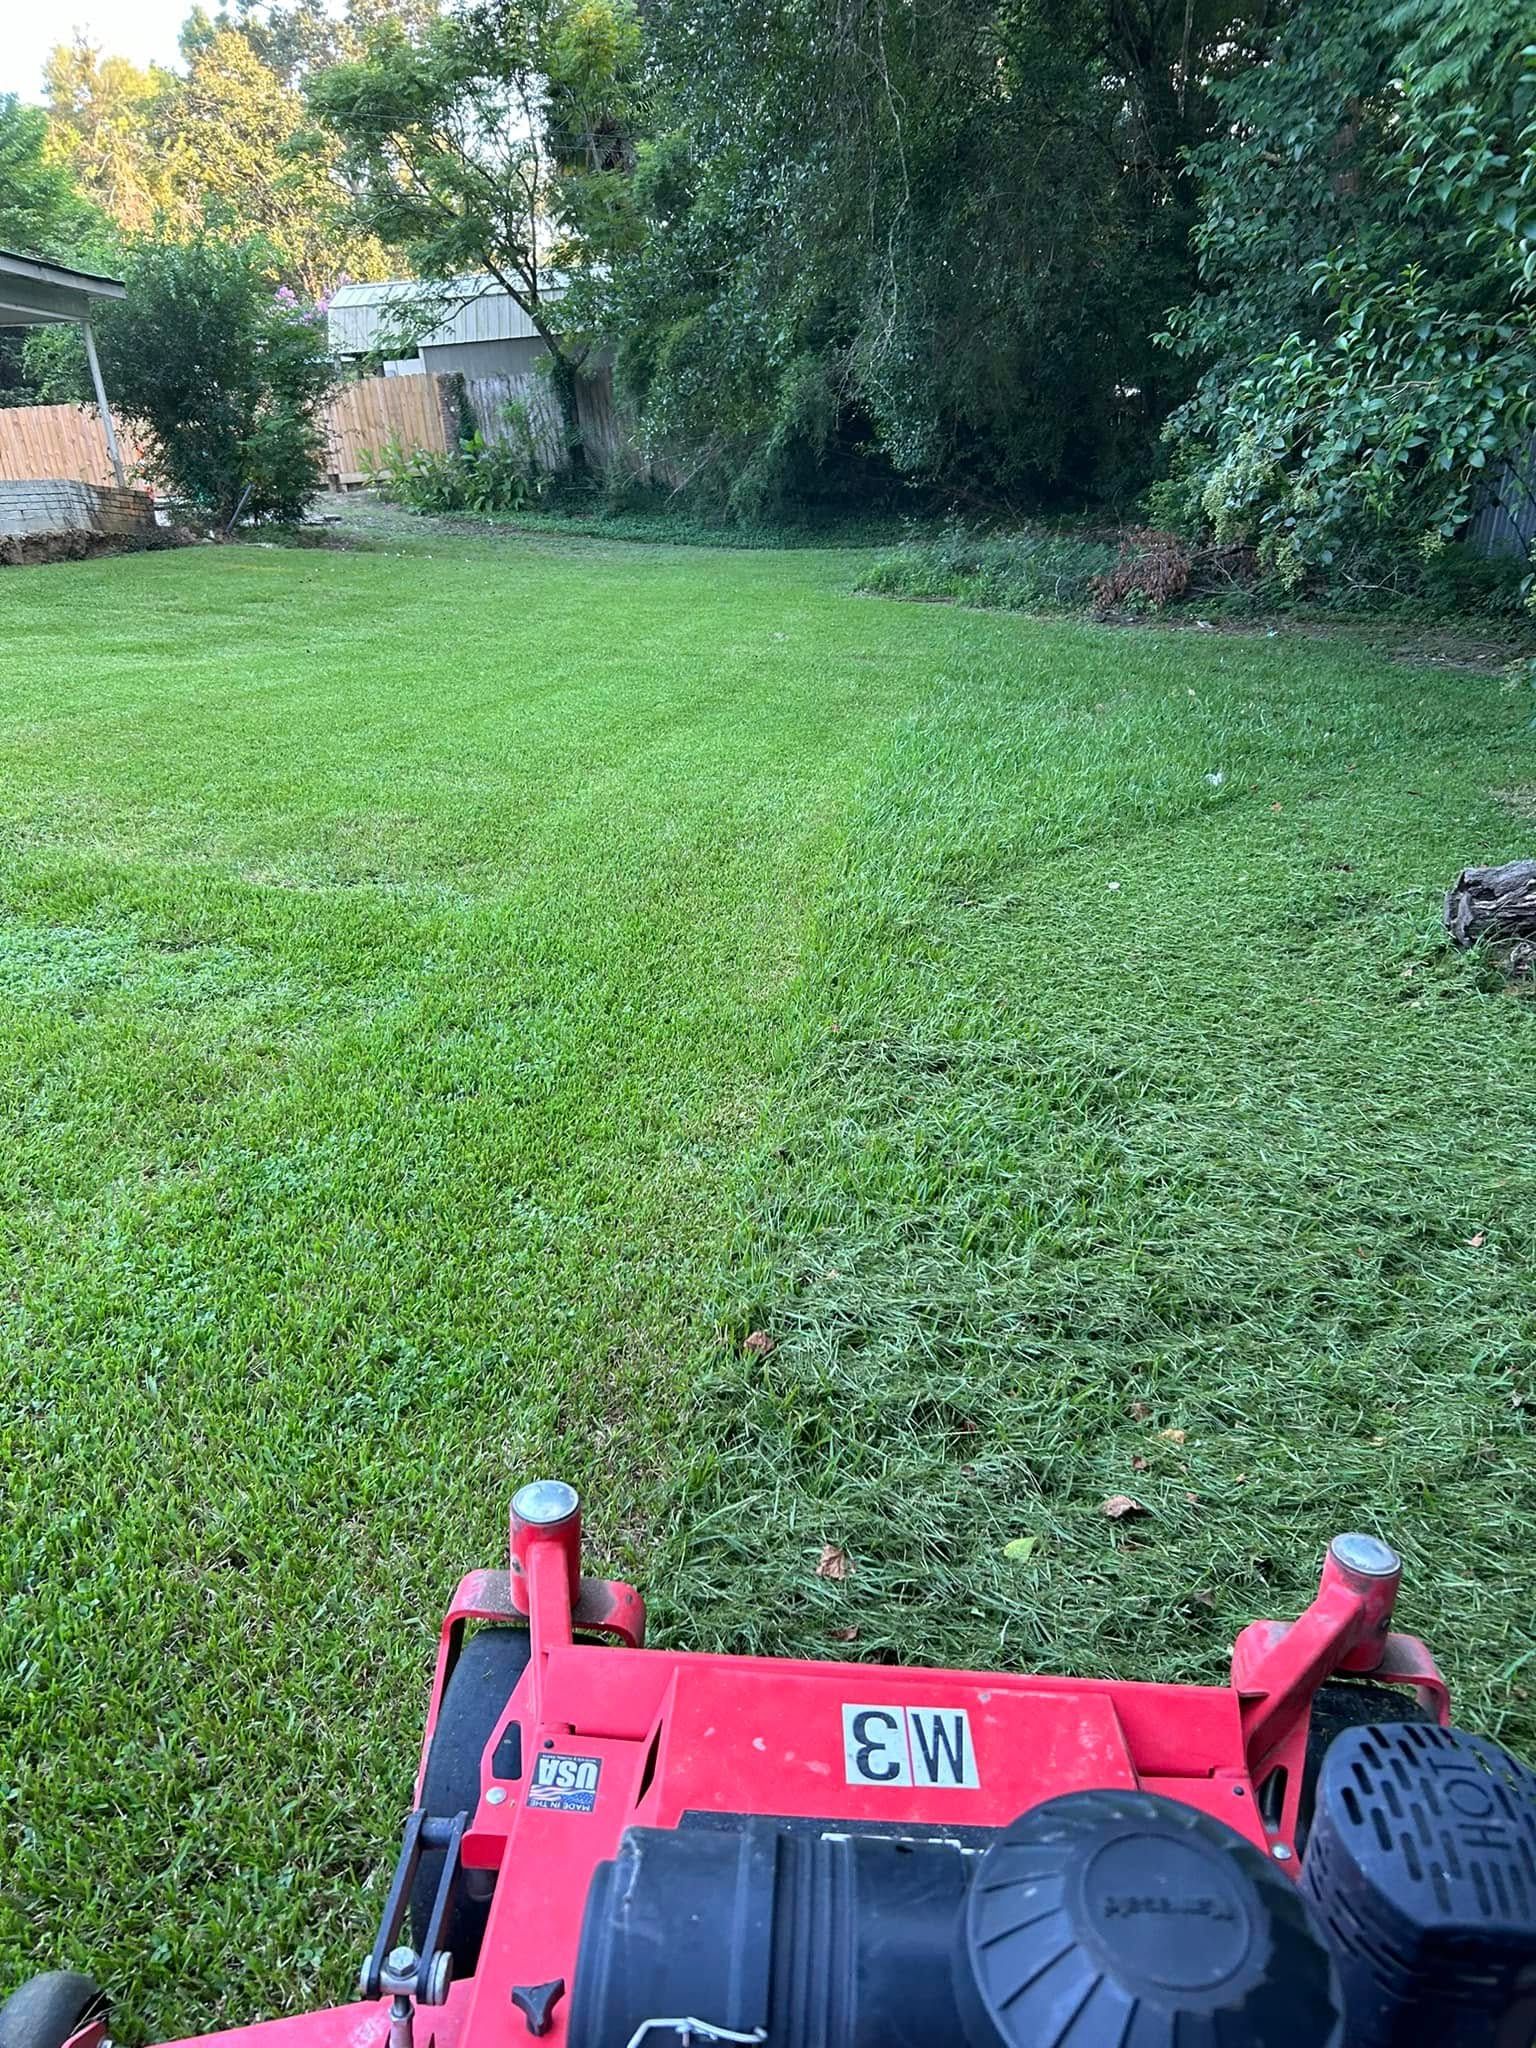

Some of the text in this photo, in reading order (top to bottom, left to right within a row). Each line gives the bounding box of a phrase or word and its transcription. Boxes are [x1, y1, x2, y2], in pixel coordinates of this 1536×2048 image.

[852, 1710, 963, 1784] M3
[538, 1758, 598, 1789] USA
[529, 1798, 591, 1812] MADE IN THE
[1427, 1756, 1513, 1851] HOT
